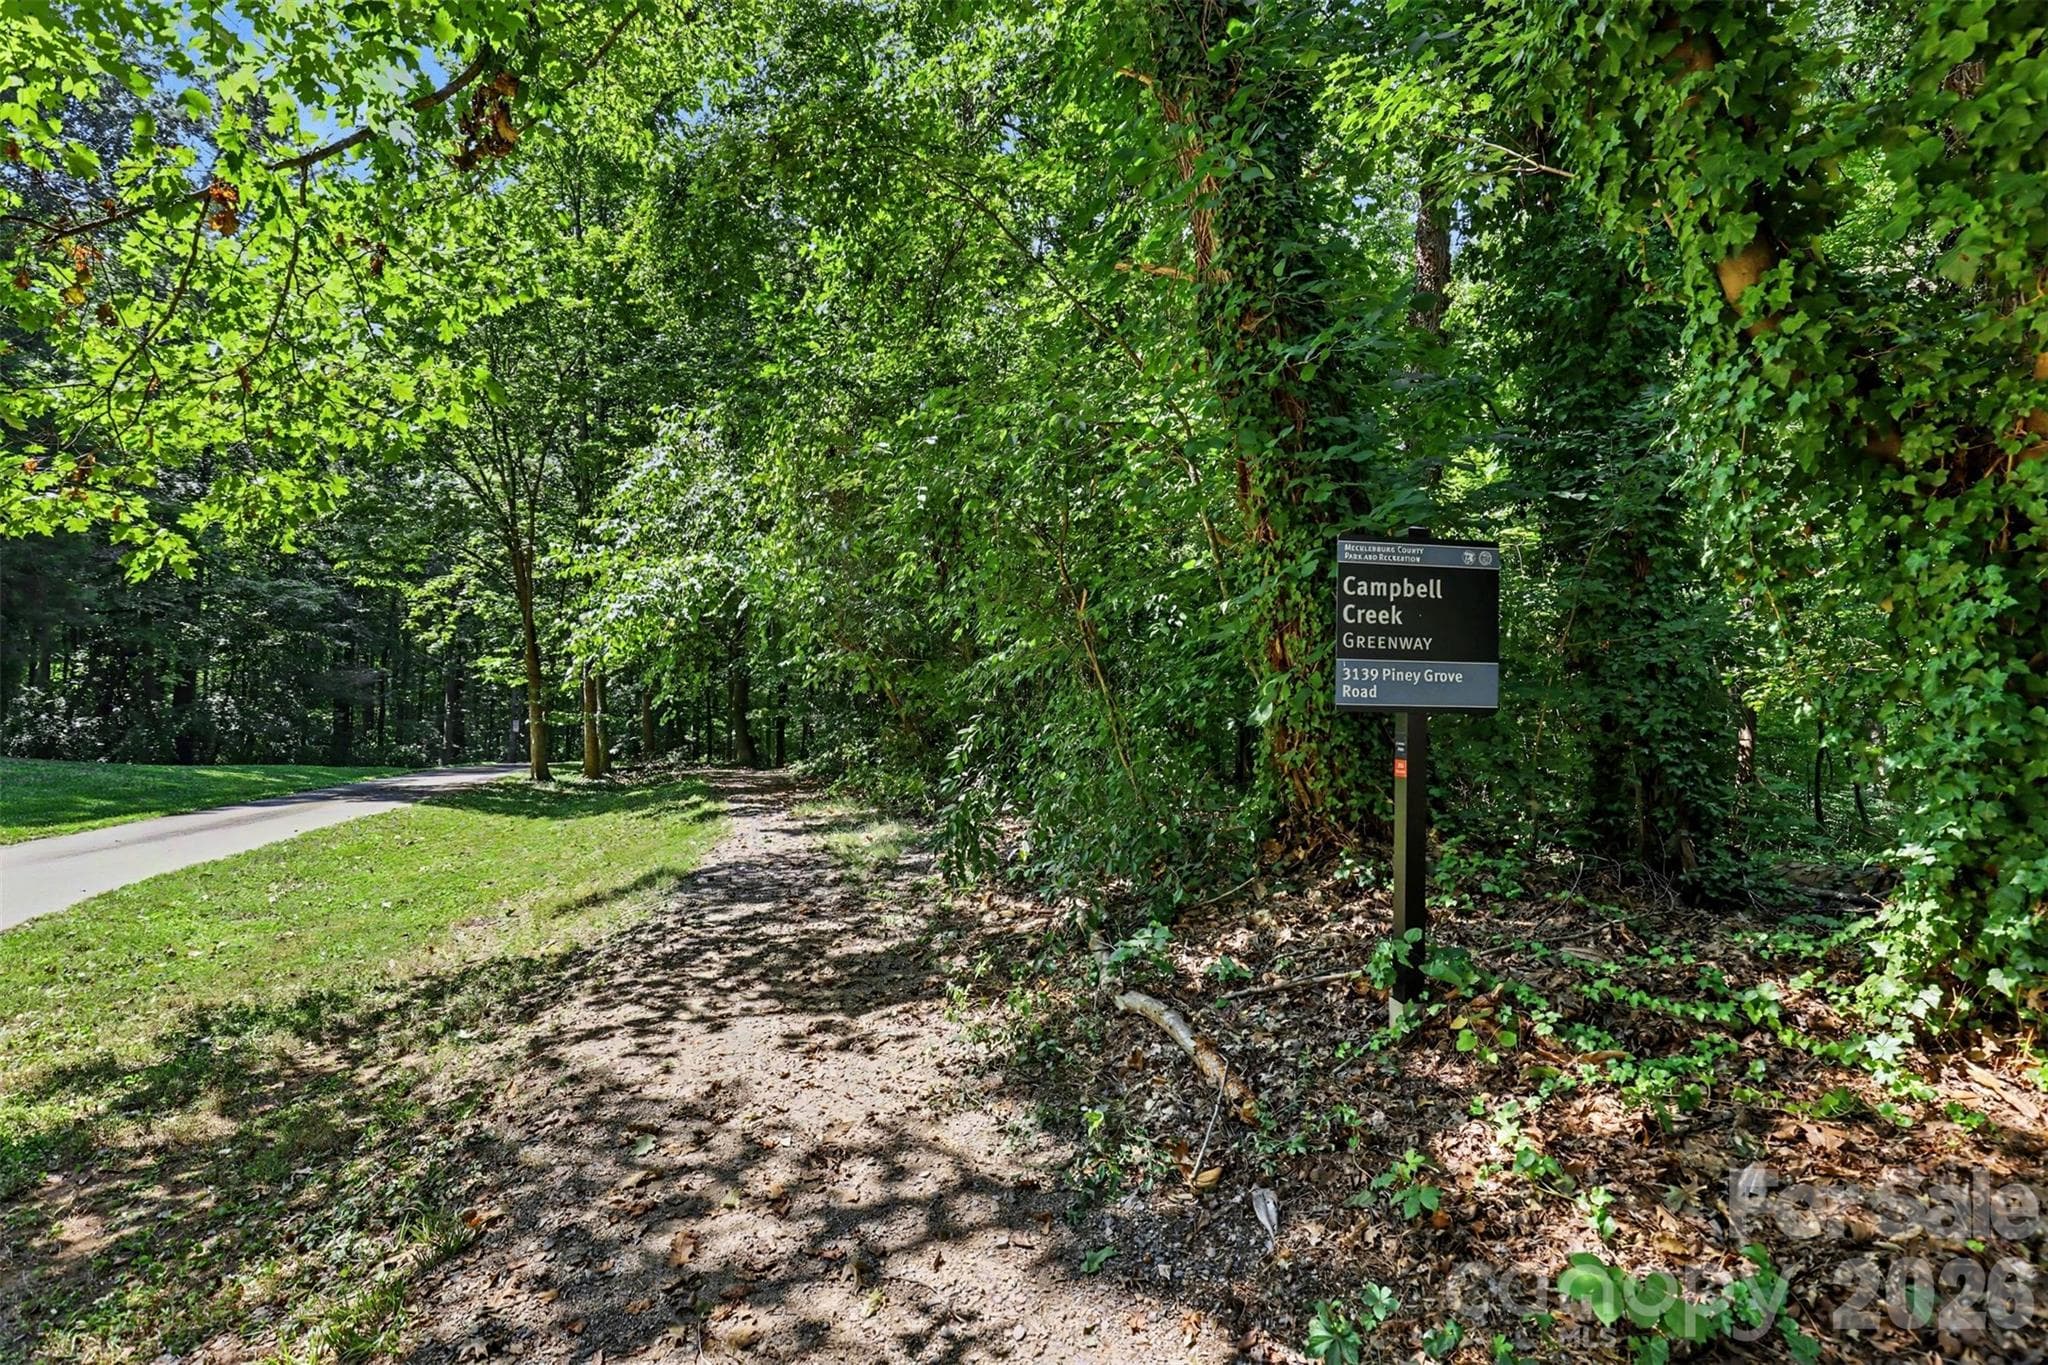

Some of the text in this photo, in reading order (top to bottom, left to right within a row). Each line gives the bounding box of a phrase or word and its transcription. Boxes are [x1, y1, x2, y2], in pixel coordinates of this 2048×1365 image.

[1344, 552, 1362, 560] PARK
[1378, 554, 1420, 562] RECREATION
[1397, 546, 1424, 554] COUNTY
[1343, 576, 1443, 602] Campbell
[1343, 604, 1403, 625] Creek
[1343, 632, 1433, 650] GREENWAY
[1343, 667, 1463, 685] 3139 Piney Grove
[1342, 685, 1377, 698] Road
